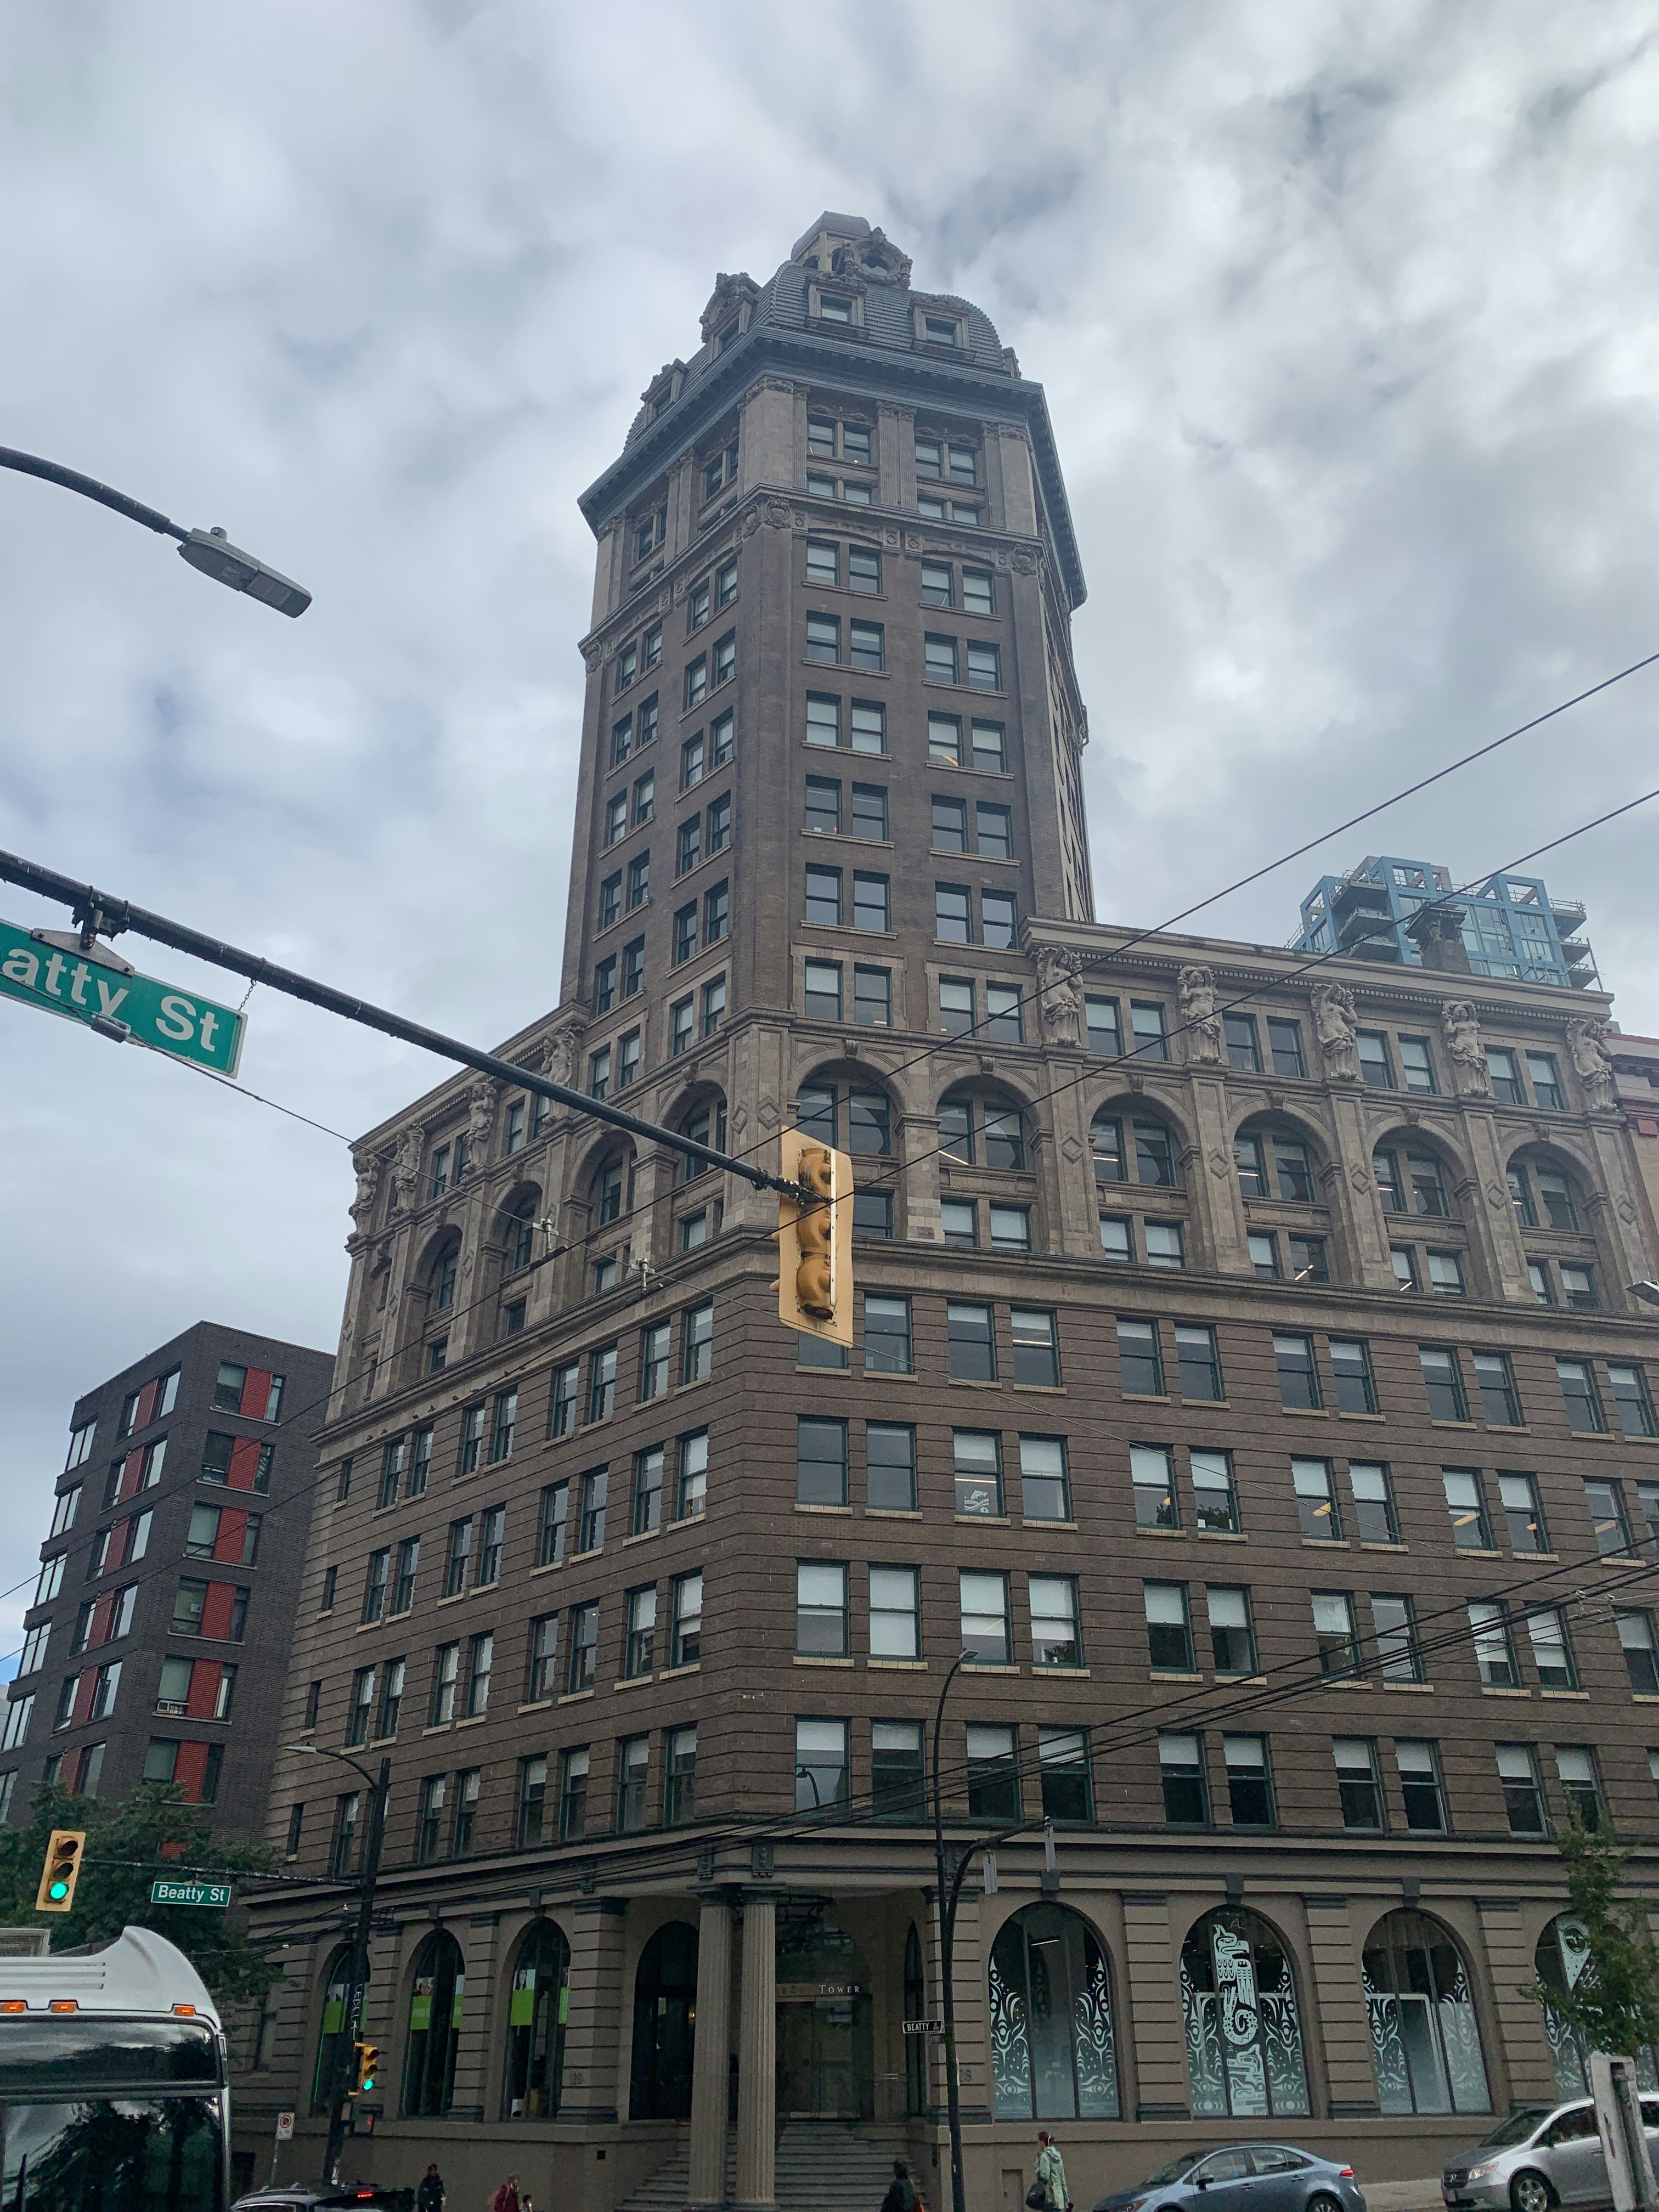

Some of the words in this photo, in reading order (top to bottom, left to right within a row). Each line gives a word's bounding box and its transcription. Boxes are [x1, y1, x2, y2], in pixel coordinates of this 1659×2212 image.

[156, 995, 219, 1052] St
[158, 1884, 205, 1903] Beatty
[210, 1887, 224, 1901] St
[907, 2022, 929, 2031] BEATTY
